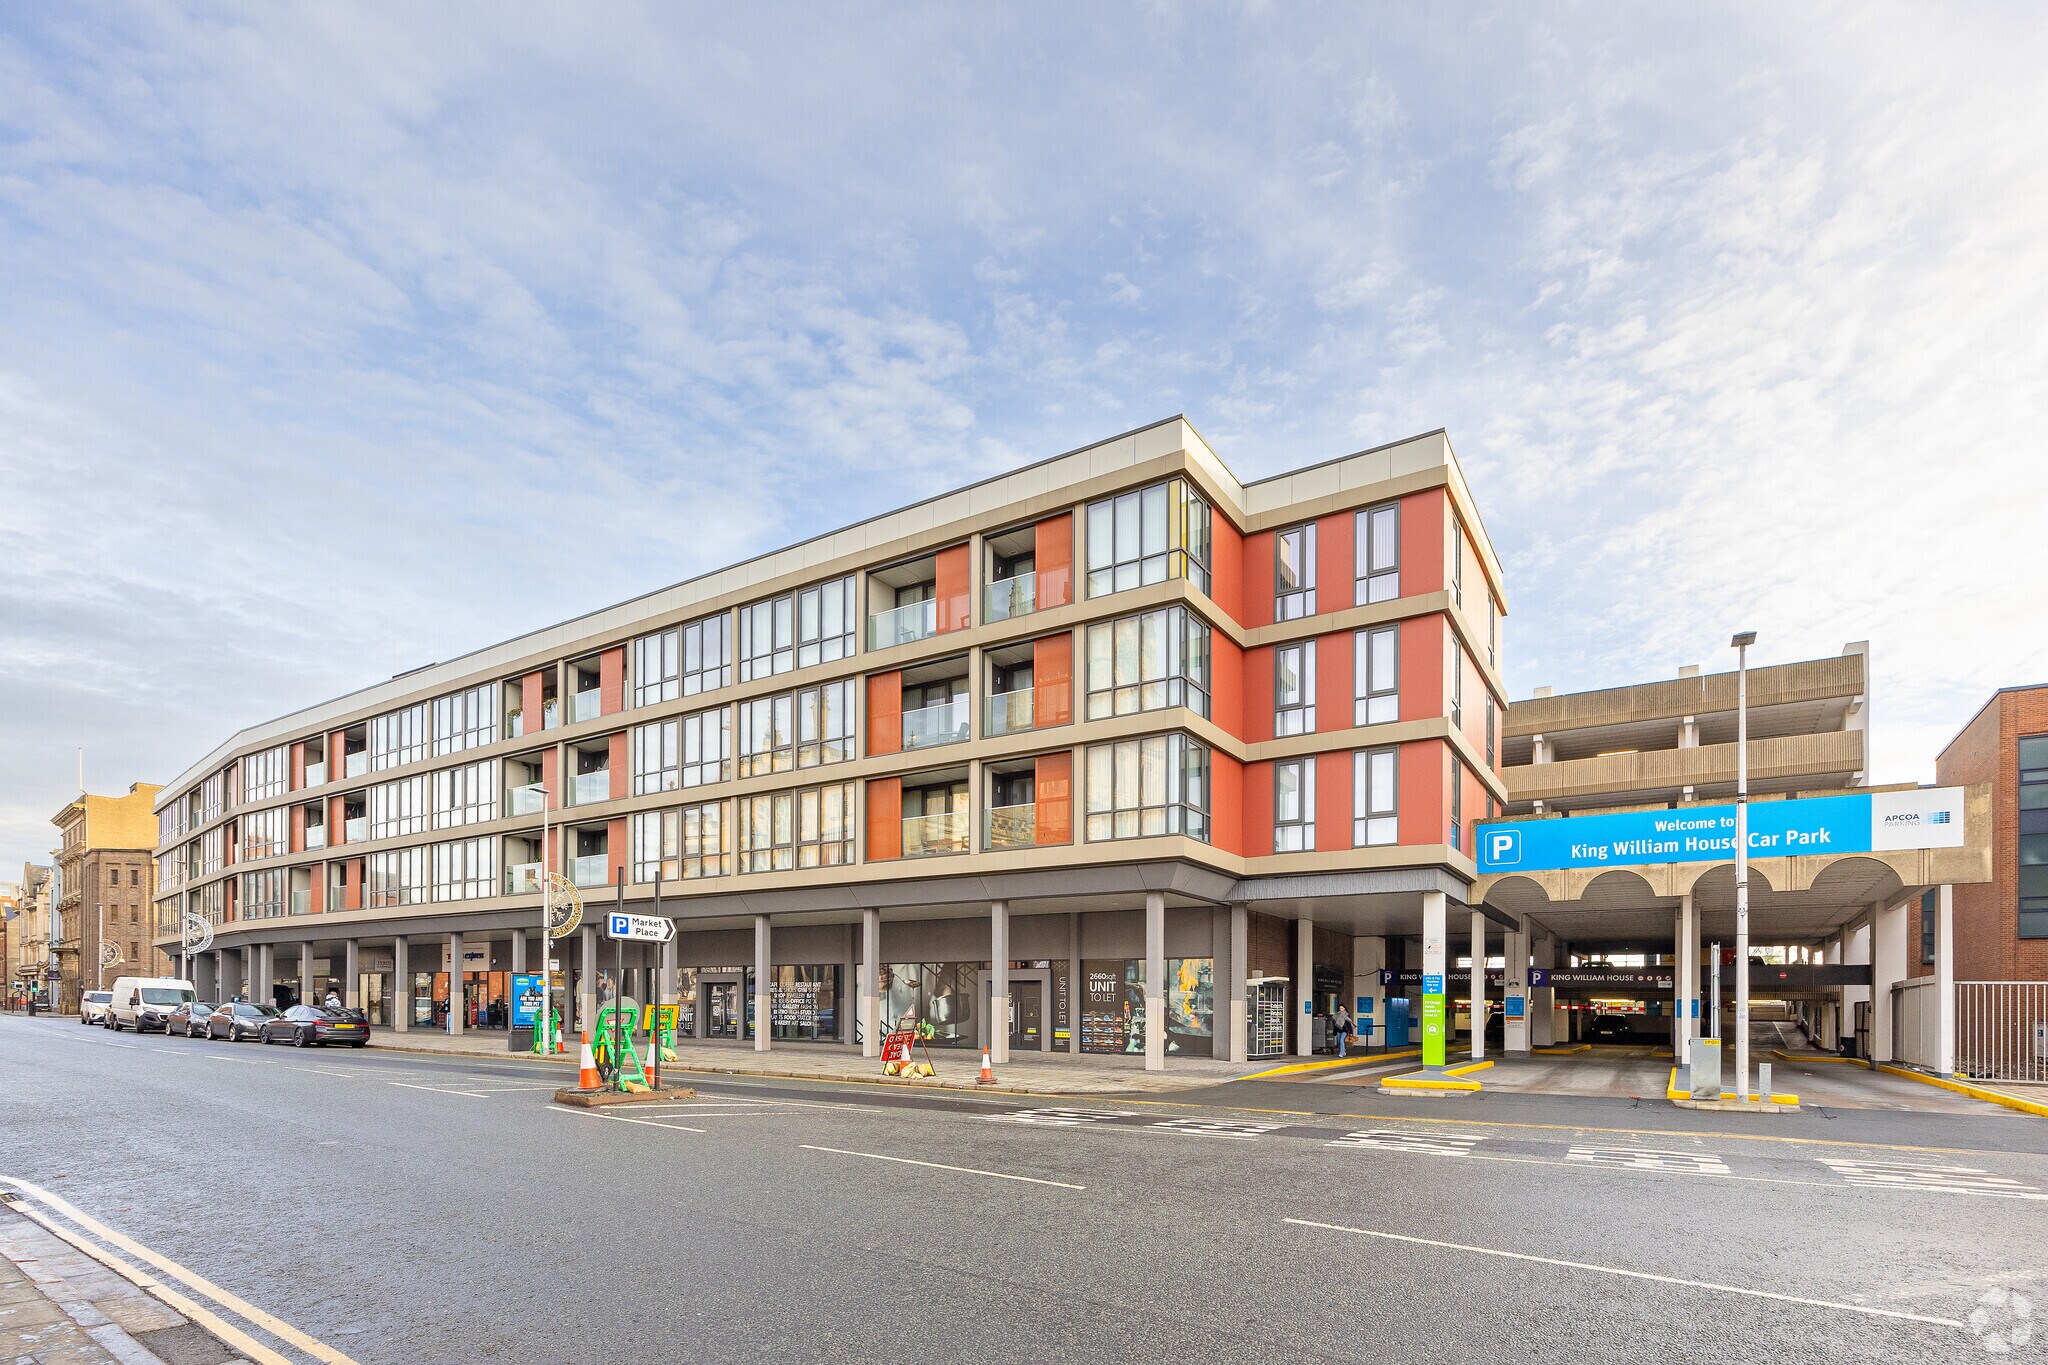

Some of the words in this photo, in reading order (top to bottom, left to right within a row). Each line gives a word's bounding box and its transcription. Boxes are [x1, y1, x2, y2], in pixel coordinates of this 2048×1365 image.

[1884, 814, 1920, 822] APCOA
[1654, 818, 1716, 832] Welcome
[1720, 816, 1732, 828] to
[1493, 835, 1513, 860] P
[1572, 844, 1608, 860] King
[1613, 840, 1678, 856] William
[1686, 837, 1737, 852] House
[1748, 832, 1780, 848] Car
[1786, 828, 1831, 846] Park
[616, 918, 627, 933] P
[632, 918, 662, 928] Market
[636, 928, 658, 937] Place
[1090, 972, 1116, 980] 2660sqft
[1384, 972, 1392, 984] P
[1532, 972, 1542, 984] P
[1090, 981, 1116, 992] UNIT
[1058, 996, 1066, 1010] TO
[1090, 993, 1102, 1002] TO
[1102, 993, 1116, 1002] LET
[678, 1013, 693, 1022] UNIT
